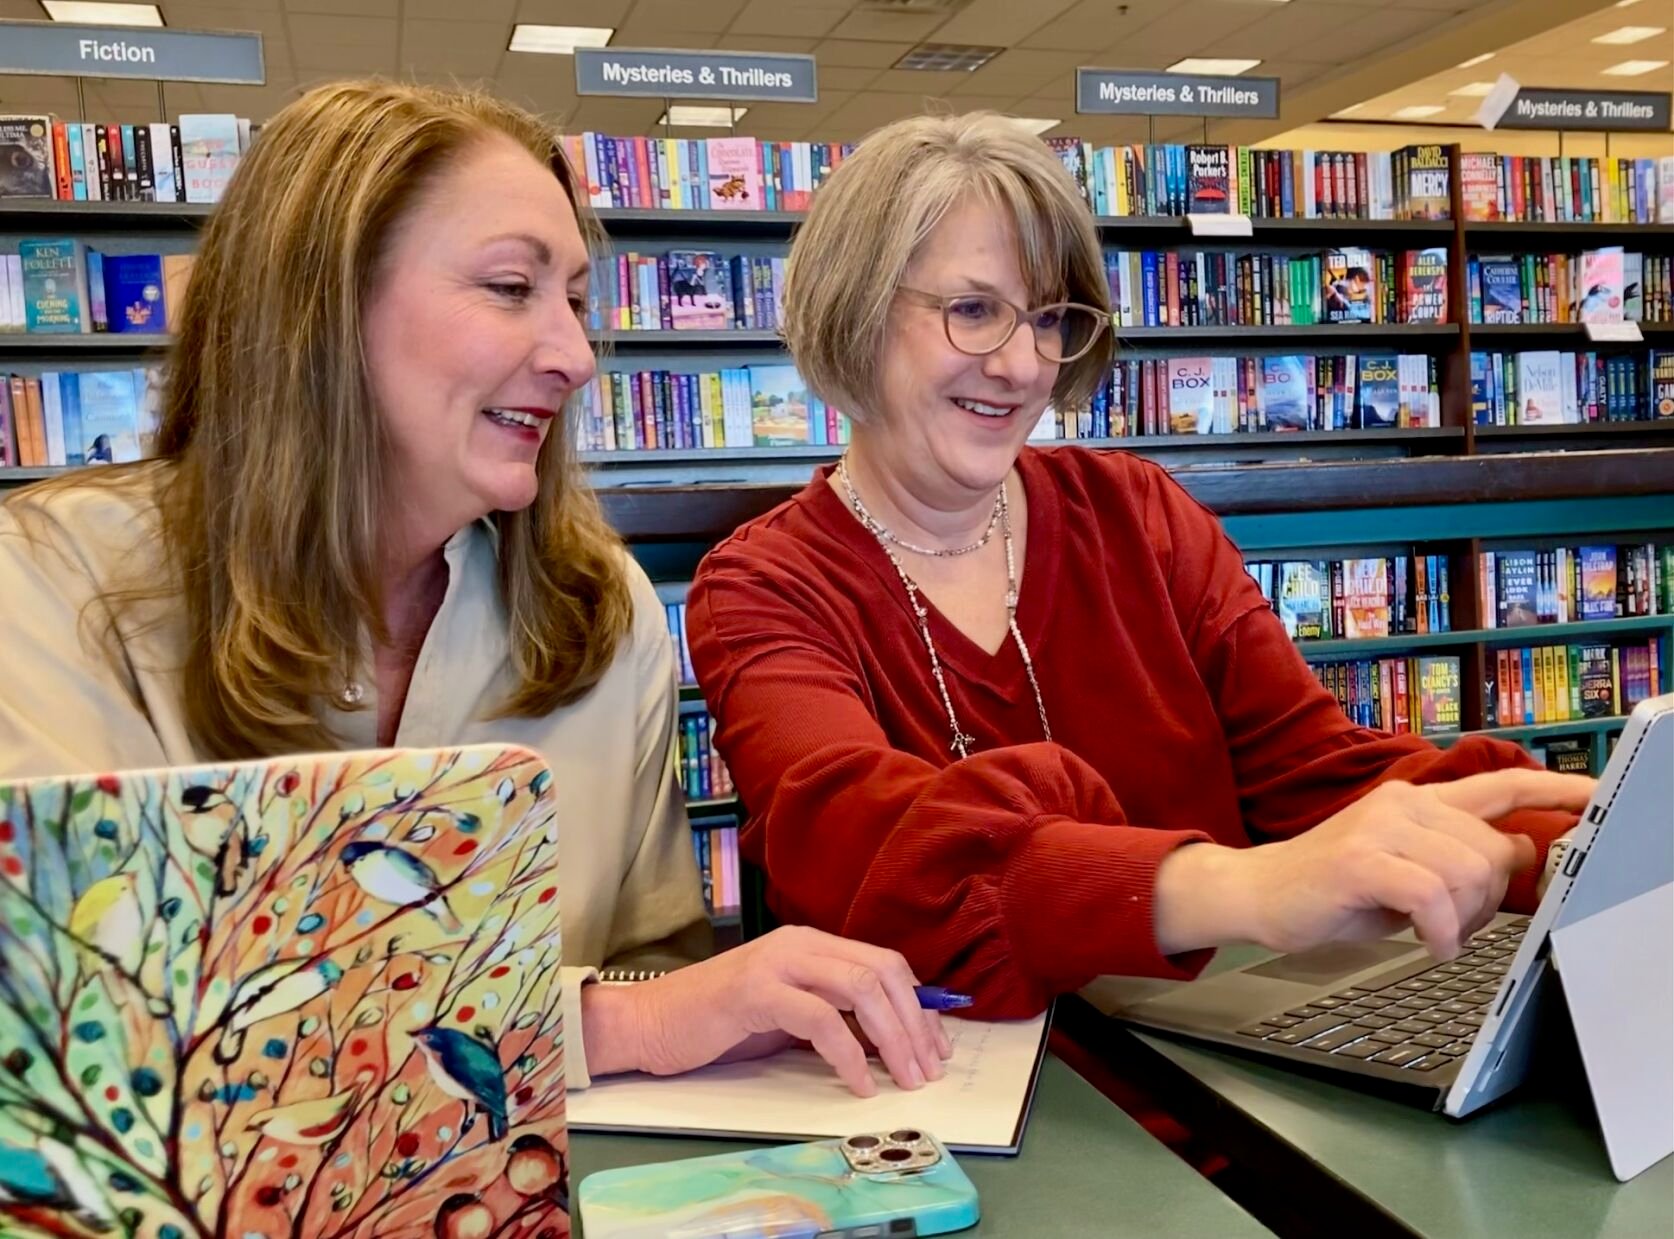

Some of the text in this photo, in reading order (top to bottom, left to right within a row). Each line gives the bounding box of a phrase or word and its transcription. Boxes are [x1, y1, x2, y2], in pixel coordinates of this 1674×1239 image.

[79, 39, 155, 63] Fiction
[602, 62, 793, 87] Mysteries & Thrillers
[1100, 82, 1259, 104] Mysteries & Thrillers
[1517, 100, 1654, 118] Mysteries & Thrillers
[1190, 150, 1219, 164] Robert
[1193, 163, 1227, 178] Parker's
[1411, 171, 1449, 198] MERCY
[36, 247, 59, 257] KEN
[1366, 360, 1380, 370] C.
[1177, 367, 1193, 378] C.
[1361, 369, 1398, 382] BOX
[1172, 377, 1212, 389] BOX
[1505, 558, 1534, 567] LISON
[1505, 566, 1535, 575] AYLIN
[1508, 577, 1533, 586] EVER
[1430, 662, 1449, 675] TOM
[1421, 674, 1459, 689] CLANCY'S
[1584, 689, 1600, 700] SIX
[1556, 752, 1589, 763] THOMAS
[1559, 762, 1588, 770] HARRIS
